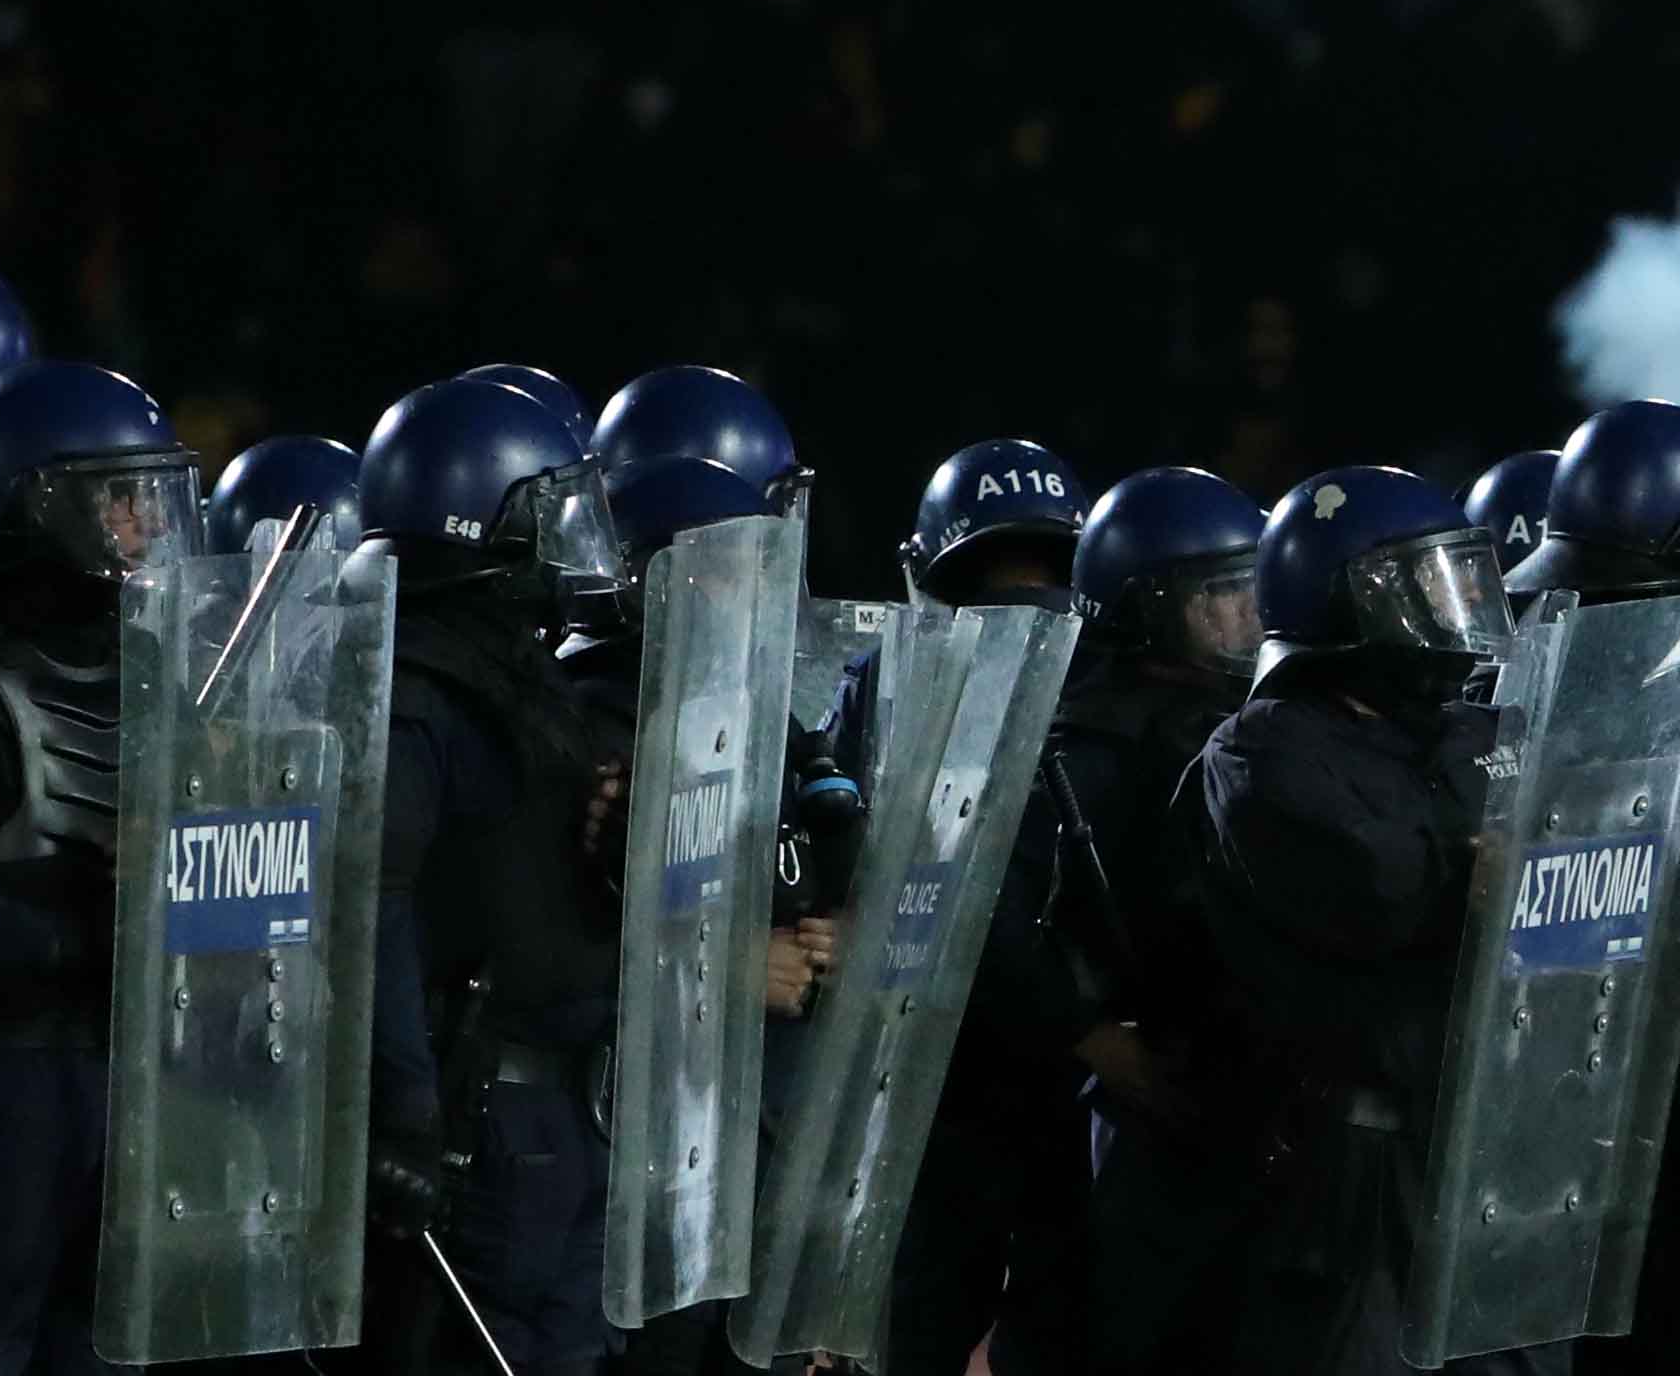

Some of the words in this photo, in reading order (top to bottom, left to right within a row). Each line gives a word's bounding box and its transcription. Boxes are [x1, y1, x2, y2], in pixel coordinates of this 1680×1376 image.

[976, 468, 1066, 501] A116
[443, 514, 482, 540] E48
[1509, 844, 1654, 931] ΑΣΤΥΝΟΜΙΑ
